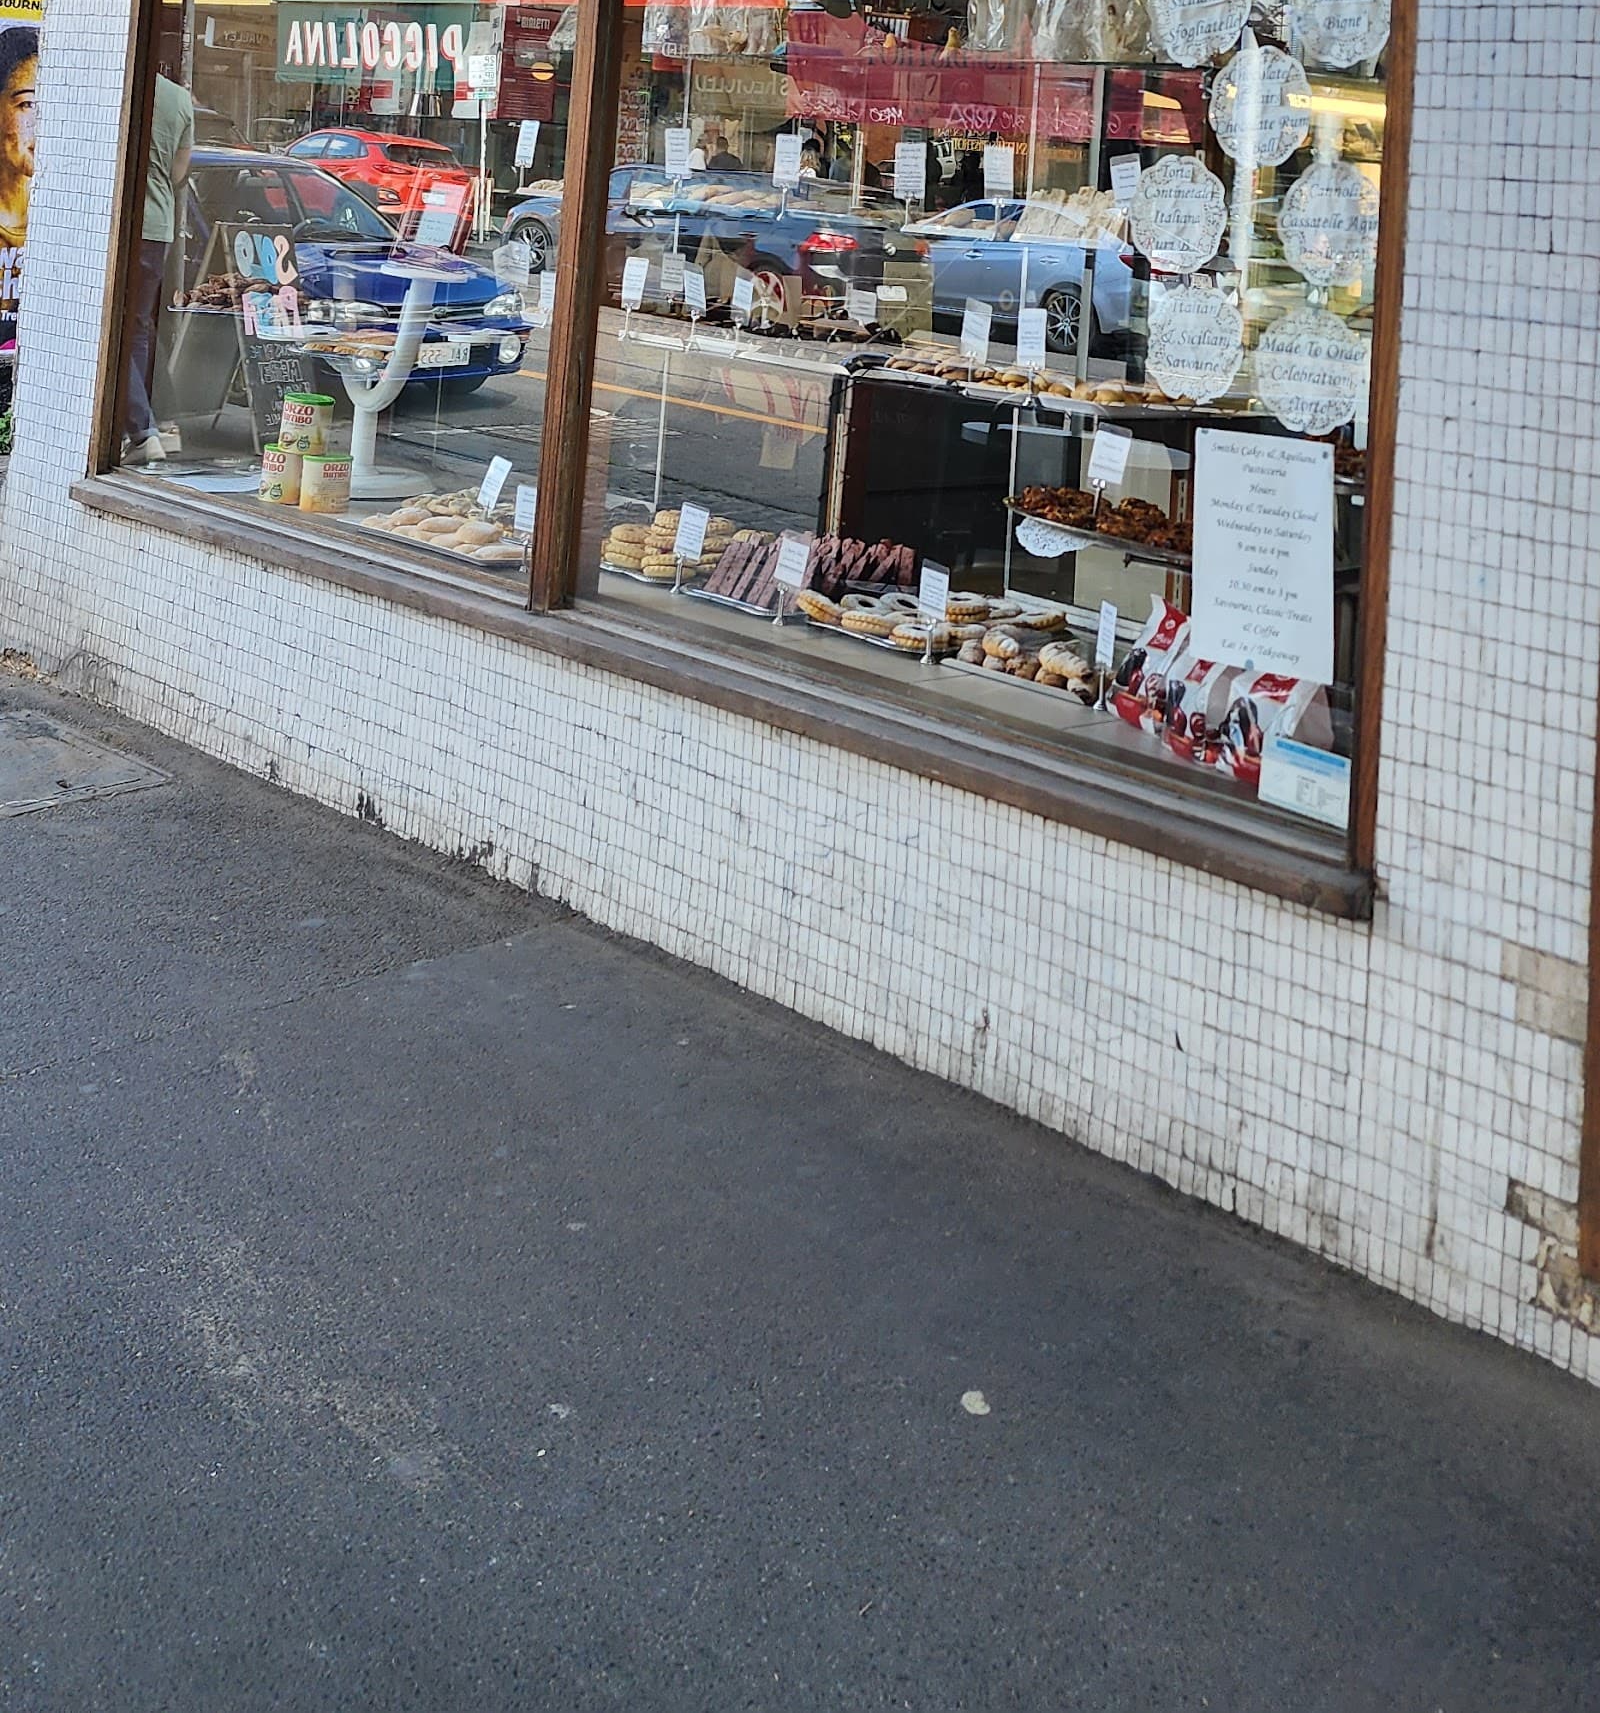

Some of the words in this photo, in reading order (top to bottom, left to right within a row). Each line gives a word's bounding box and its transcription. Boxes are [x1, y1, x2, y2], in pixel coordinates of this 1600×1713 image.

[1161, 329, 1176, 345] &
[1262, 334, 1301, 354] Made
[1306, 341, 1322, 358] To
[1327, 343, 1367, 361] Order
[284, 402, 315, 416] ORZO
[323, 463, 350, 472] ORZO
